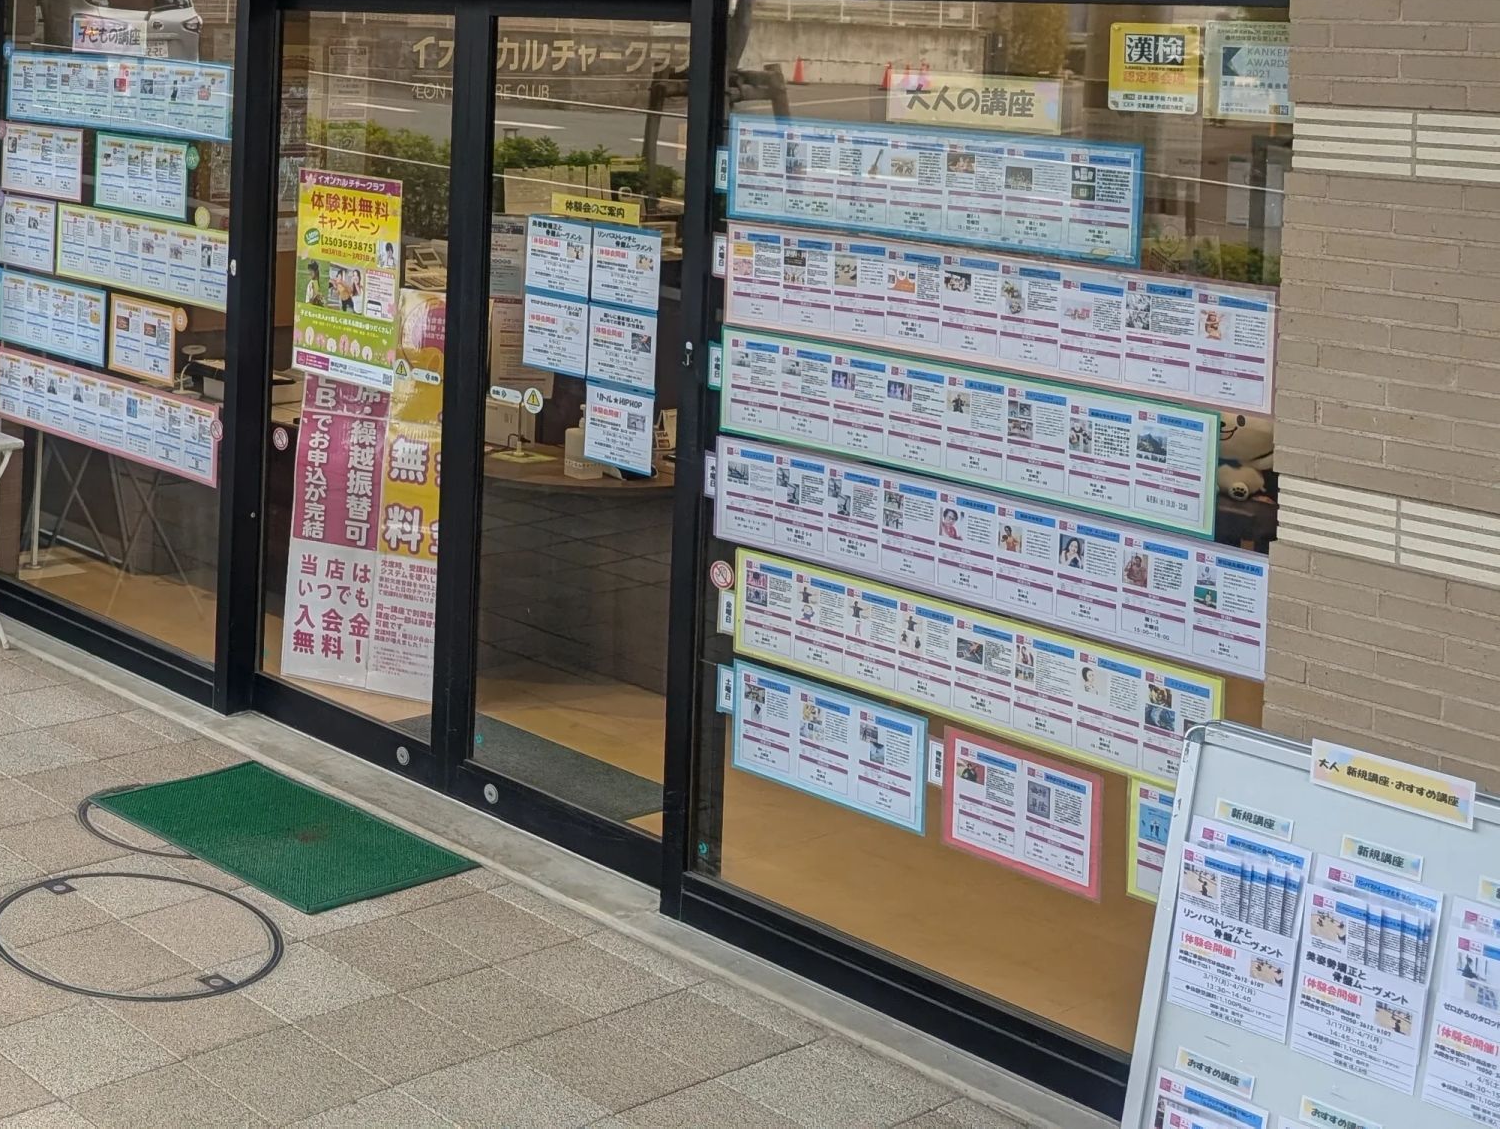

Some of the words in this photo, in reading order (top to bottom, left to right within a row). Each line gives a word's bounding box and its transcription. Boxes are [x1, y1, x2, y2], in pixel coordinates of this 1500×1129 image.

[77, 25, 141, 47] 子どもの講座
[1126, 35, 1184, 64] 漢検
[516, 84, 550, 99] CLUB
[905, 84, 1036, 119] 大人の講座
[318, 174, 386, 192] イオンカルチャークラブ
[311, 191, 390, 222] 体験料無料
[565, 200, 625, 219] 体験会のご案内
[318, 213, 380, 235] キャンペーン
[382, 437, 429, 553] 無料
[301, 554, 372, 584] 当店は
[299, 579, 371, 609] いつでも
[294, 604, 371, 638] 入会金
[376, 612, 436, 628] 講座の一部は振替
[292, 630, 363, 664] 無料！
[1318, 758, 1340, 773] 大人
[1346, 765, 1461, 808] 新規講座・おすすめ講座
[1231, 807, 1275, 831] 新規講座
[1357, 844, 1405, 869] 新規講座
[1183, 908, 1252, 939] リンパストレッチと
[1214, 928, 1283, 958] 骨盤ムーヴメント
[1332, 971, 1409, 1005] 骨盤ムーヴメント
[1187, 1057, 1240, 1087] おすすめ講座
